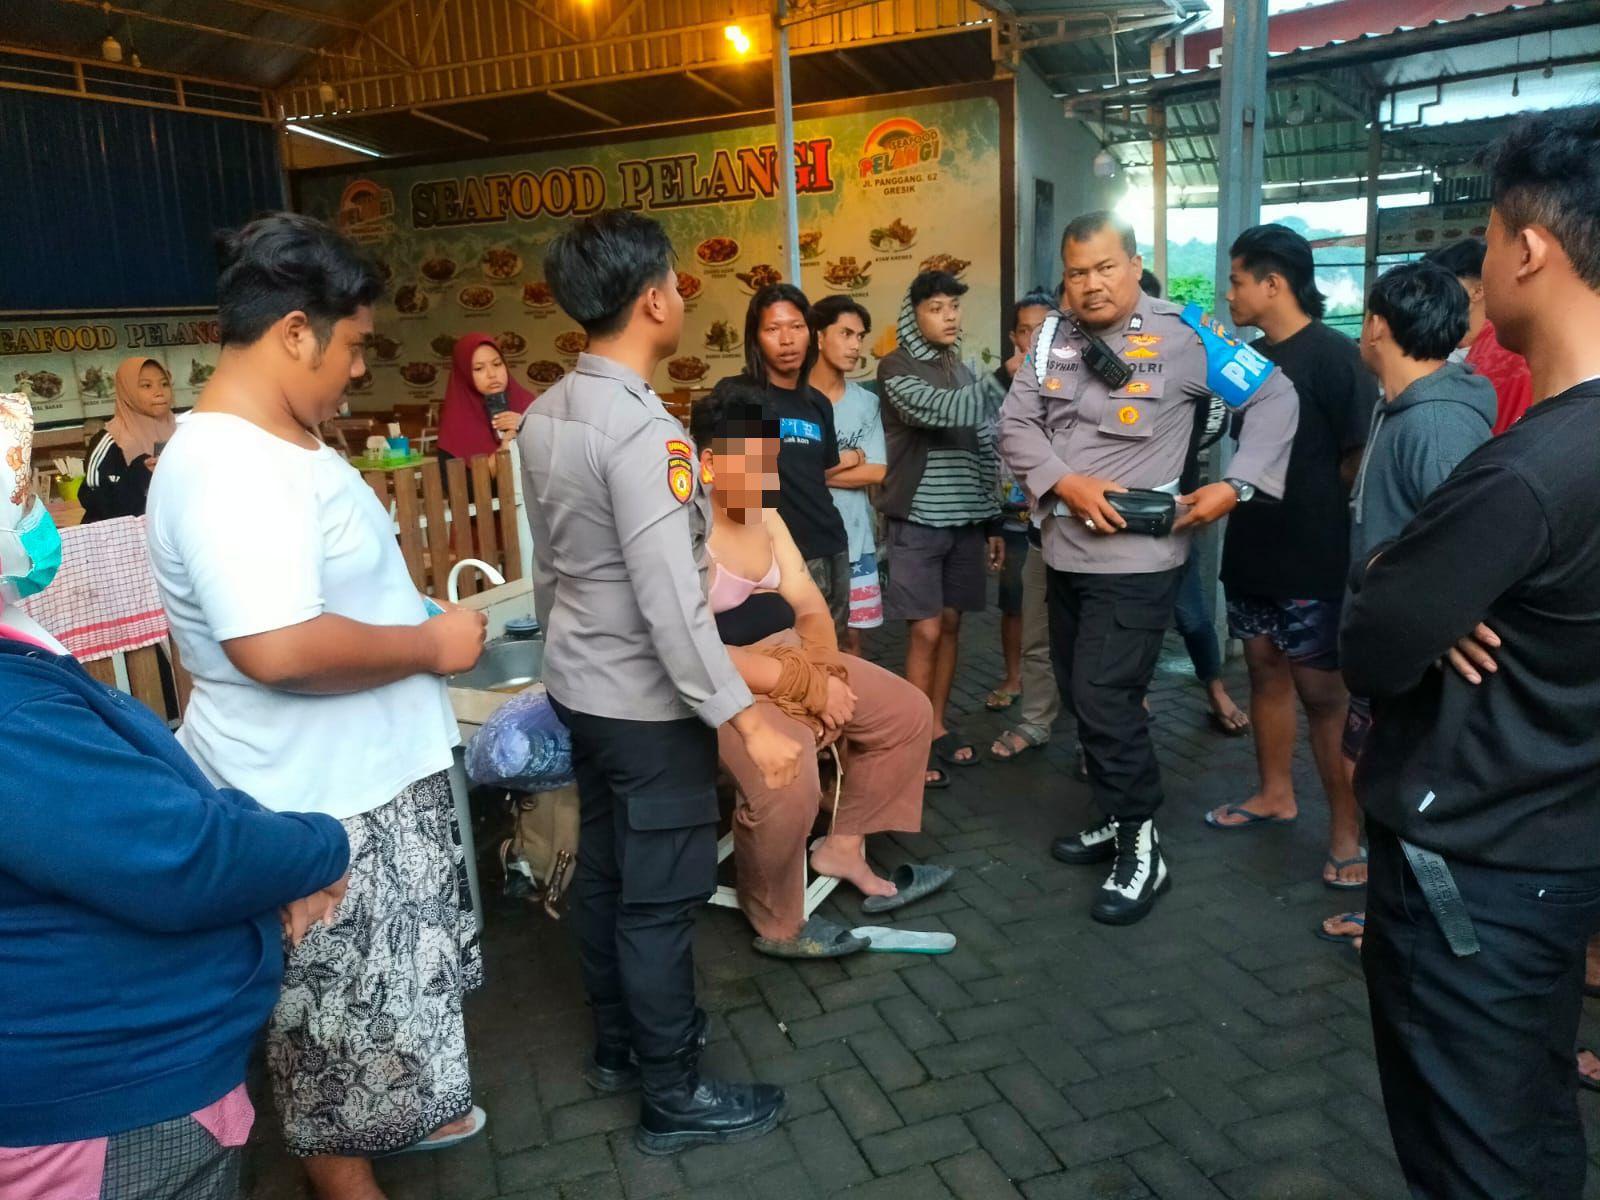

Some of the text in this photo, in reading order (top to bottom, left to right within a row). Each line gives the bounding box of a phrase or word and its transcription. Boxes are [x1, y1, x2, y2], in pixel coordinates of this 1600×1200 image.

[889, 128, 938, 150] SEAFOOD
[858, 141, 940, 178] PELANGI
[411, 138, 834, 230] SEAFOOD PELANGI
[883, 185, 916, 195] GRESIK
